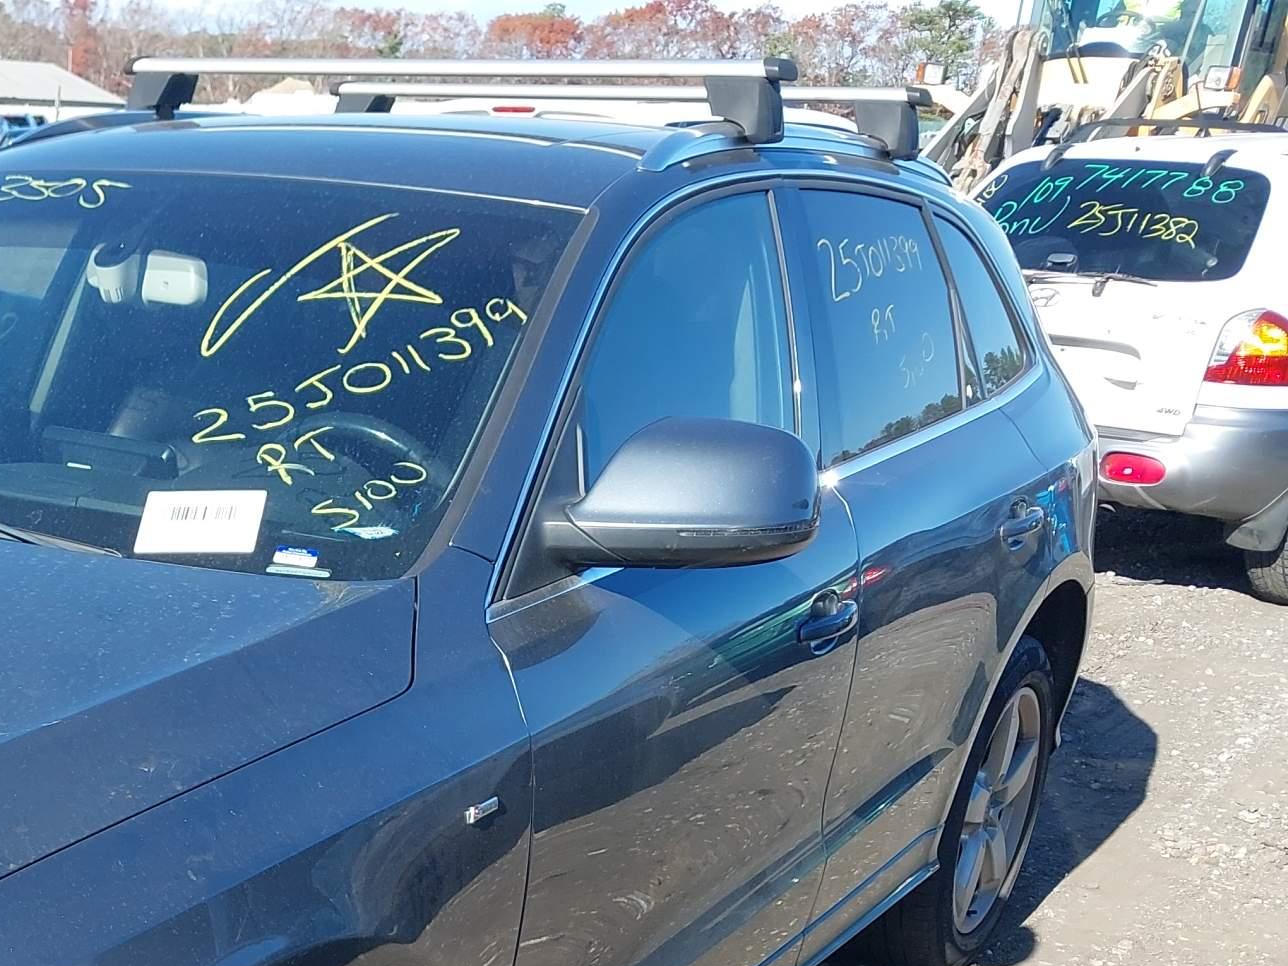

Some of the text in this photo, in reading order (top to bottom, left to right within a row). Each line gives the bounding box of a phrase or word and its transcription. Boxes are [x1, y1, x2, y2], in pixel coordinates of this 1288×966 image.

[817, 234, 922, 302] 25J011399
[191, 297, 528, 444] 25J011399
[256, 425, 336, 486] RT
